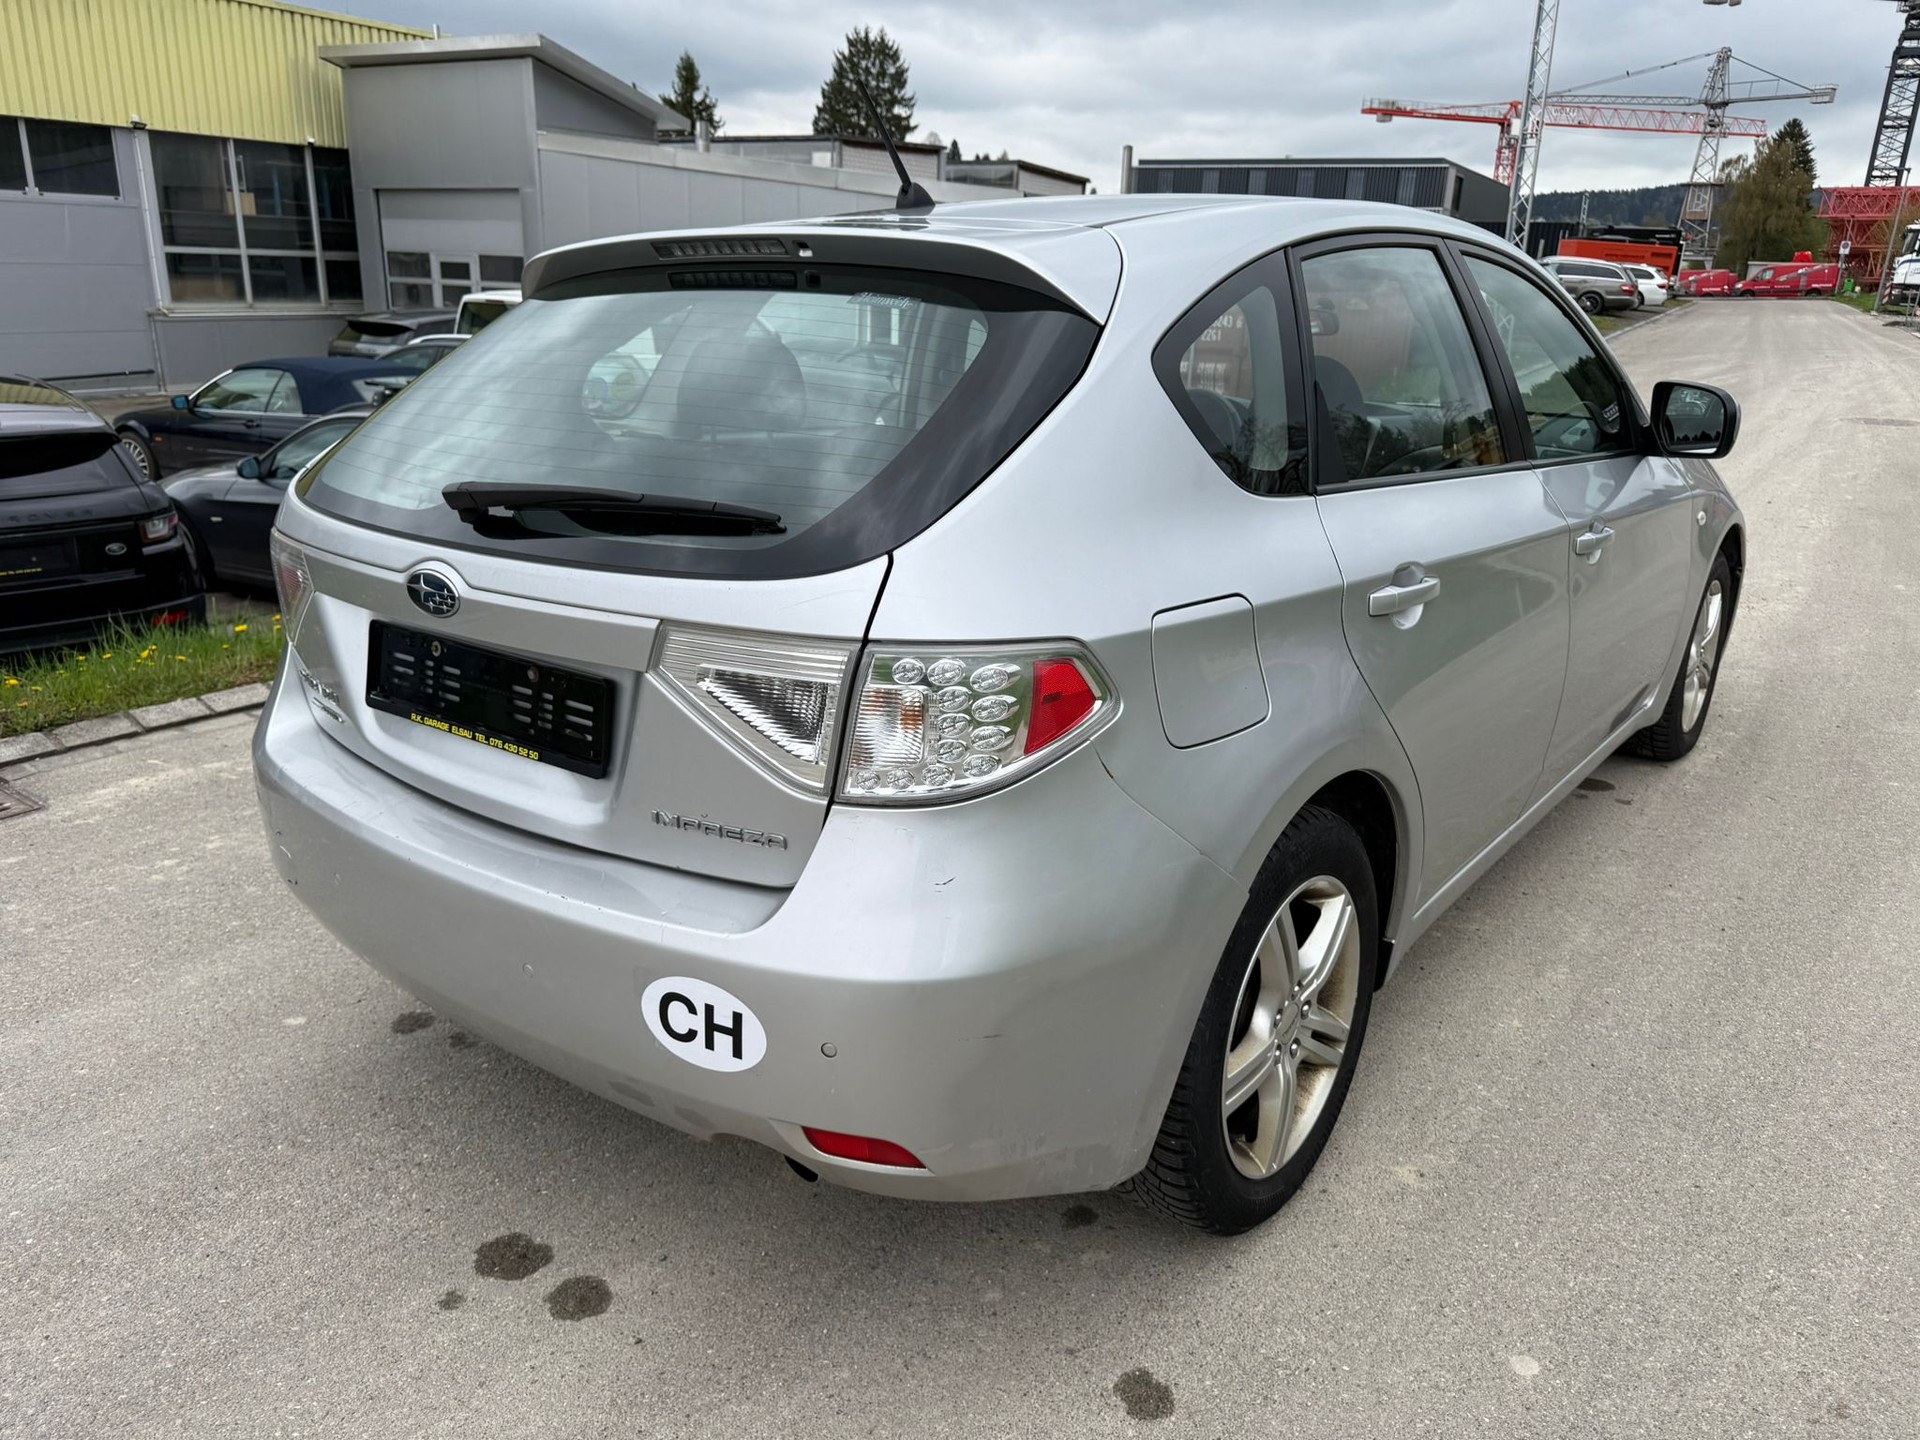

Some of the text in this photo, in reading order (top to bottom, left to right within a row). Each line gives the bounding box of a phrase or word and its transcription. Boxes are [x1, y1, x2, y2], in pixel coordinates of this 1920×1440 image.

[424, 717, 450, 732] GARAGE
[451, 725, 473, 739] ELSAU
[474, 732, 488, 744] TEL.
[489, 737, 503, 749] 076
[503, 742, 518, 753] 430
[518, 747, 528, 757] 52
[529, 750, 539, 760] 50
[651, 808, 788, 851] IMPREZA
[658, 991, 743, 1061] CH
